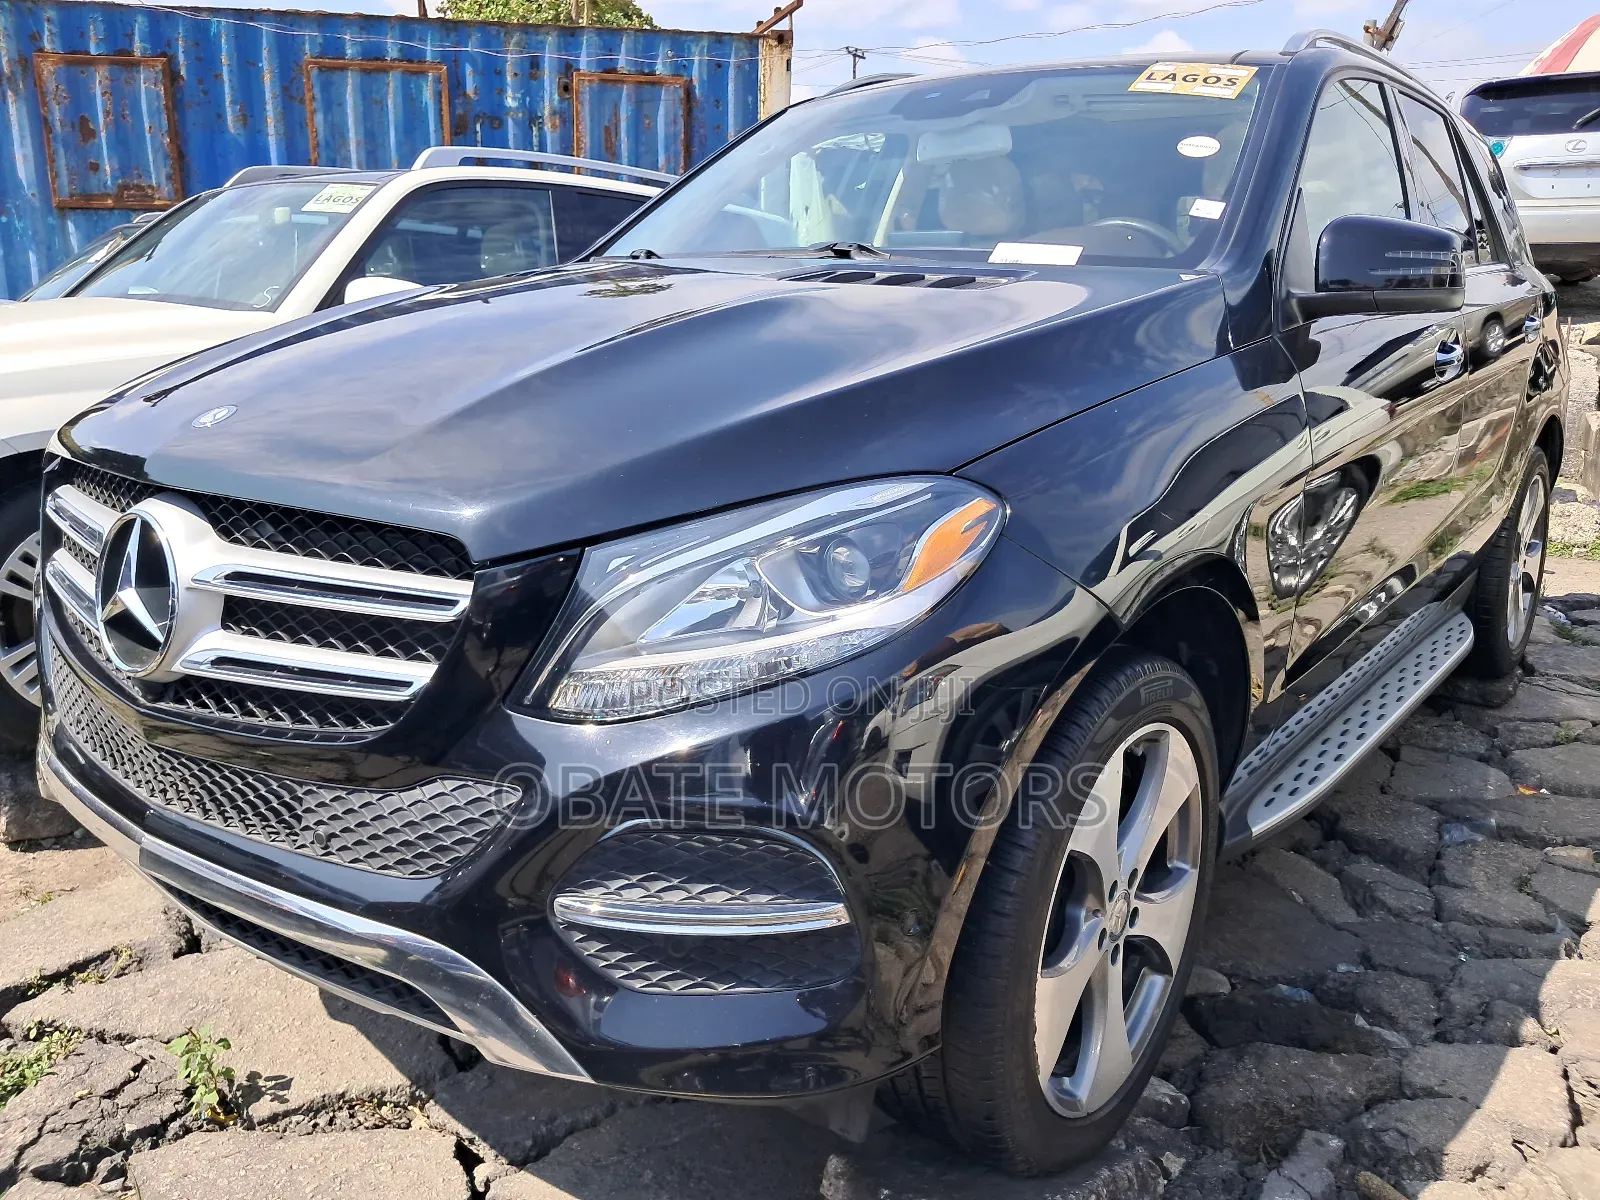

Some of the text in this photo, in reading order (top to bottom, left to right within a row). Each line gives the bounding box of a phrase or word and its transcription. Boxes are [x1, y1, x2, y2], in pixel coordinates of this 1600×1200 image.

[1145, 72, 1240, 87] LAGOS
[315, 194, 363, 204] LAGOS
[1140, 679, 1174, 706] PIRELLI
